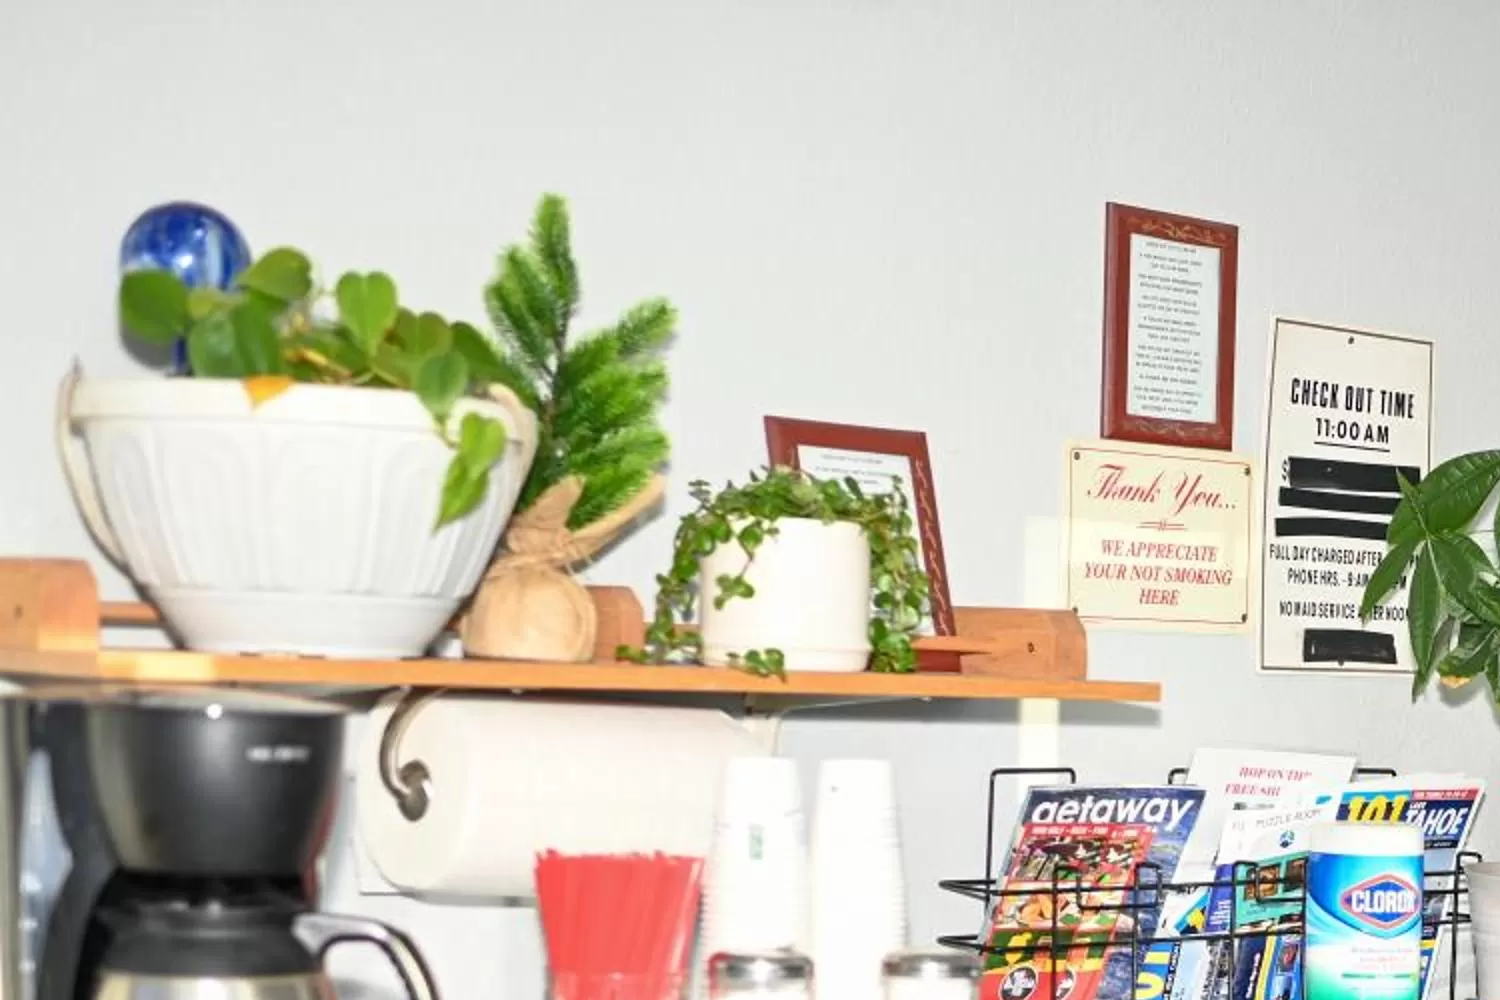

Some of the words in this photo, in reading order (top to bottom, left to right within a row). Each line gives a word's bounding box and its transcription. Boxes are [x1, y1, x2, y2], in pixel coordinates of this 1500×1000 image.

[1291, 377, 1339, 408] CHECK
[1345, 385, 1374, 414] OUT
[1380, 389, 1415, 419] TIME
[1315, 417, 1360, 440] 11:00
[1364, 423, 1389, 444] AM
[1086, 463, 1165, 504] Thank
[1101, 539, 1125, 558] WE
[1126, 541, 1219, 563] APPRECIATE
[1269, 543, 1291, 561] FULL
[1293, 545, 1311, 562] DAY
[1311, 547, 1353, 565] CHARGED
[1084, 561, 1128, 581] YOUR
[1130, 564, 1163, 583] NOT
[1164, 567, 1233, 586] SMOKING
[1287, 567, 1319, 586] PHONE
[1319, 569, 1341, 587] HRS.
[1138, 587, 1180, 606] HERE
[1279, 601, 1293, 617] NO
[1294, 601, 1316, 617] MAID
[1318, 602, 1355, 619] SERVICE
[1405, 807, 1469, 836] TAHOE
